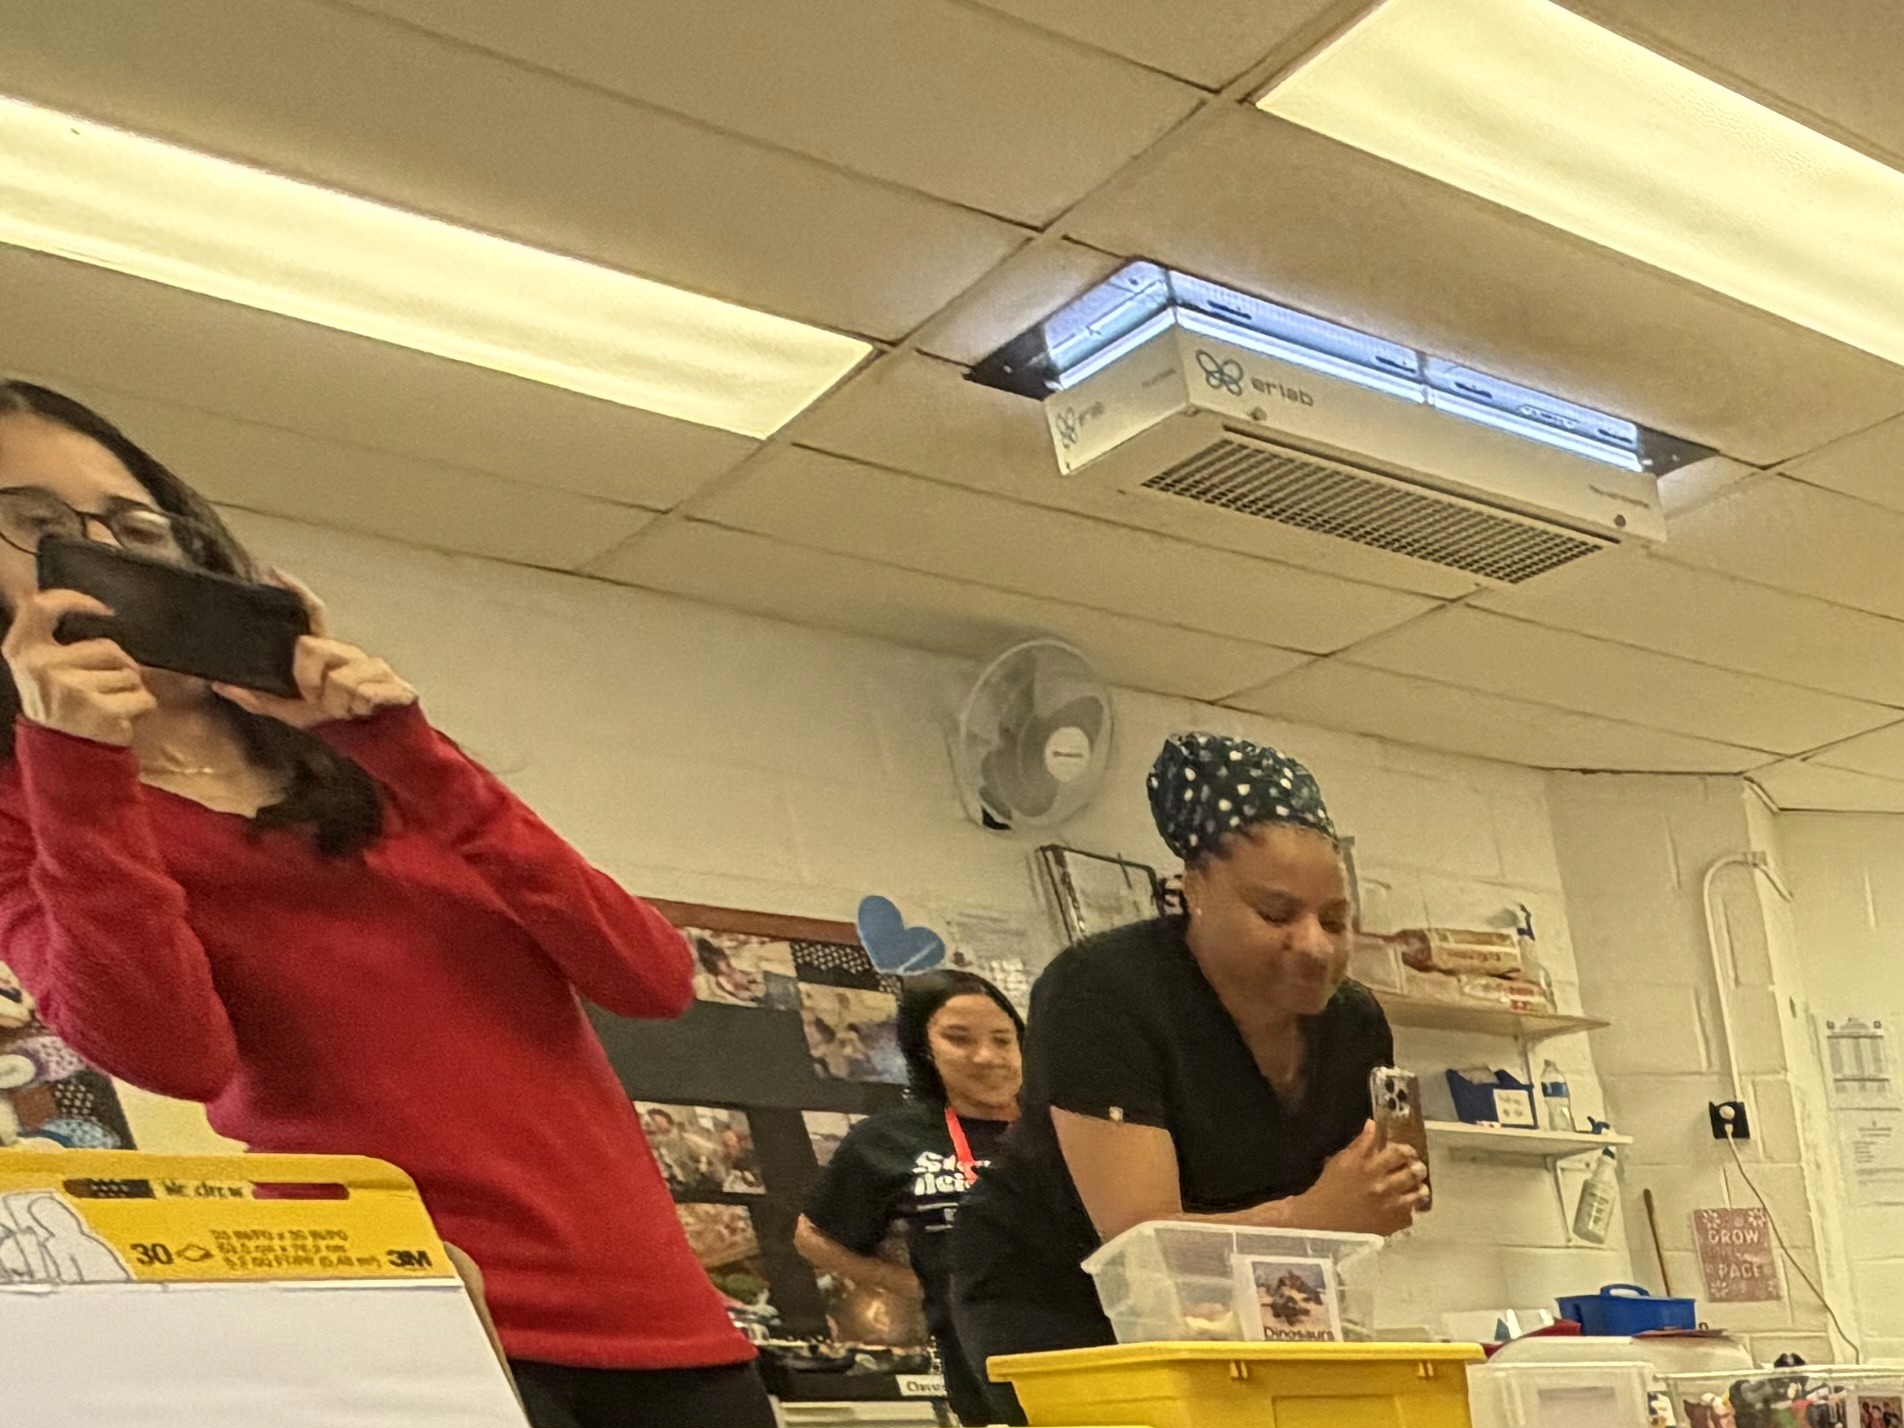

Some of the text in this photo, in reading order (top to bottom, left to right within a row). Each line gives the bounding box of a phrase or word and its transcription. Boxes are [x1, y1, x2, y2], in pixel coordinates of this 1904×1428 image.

[1250, 379, 1313, 406] erlab
[1708, 1229, 1759, 1244] GROW
[130, 1243, 174, 1267] 30
[386, 1250, 433, 1268] 3M
[1719, 1262, 1761, 1279] PACE
